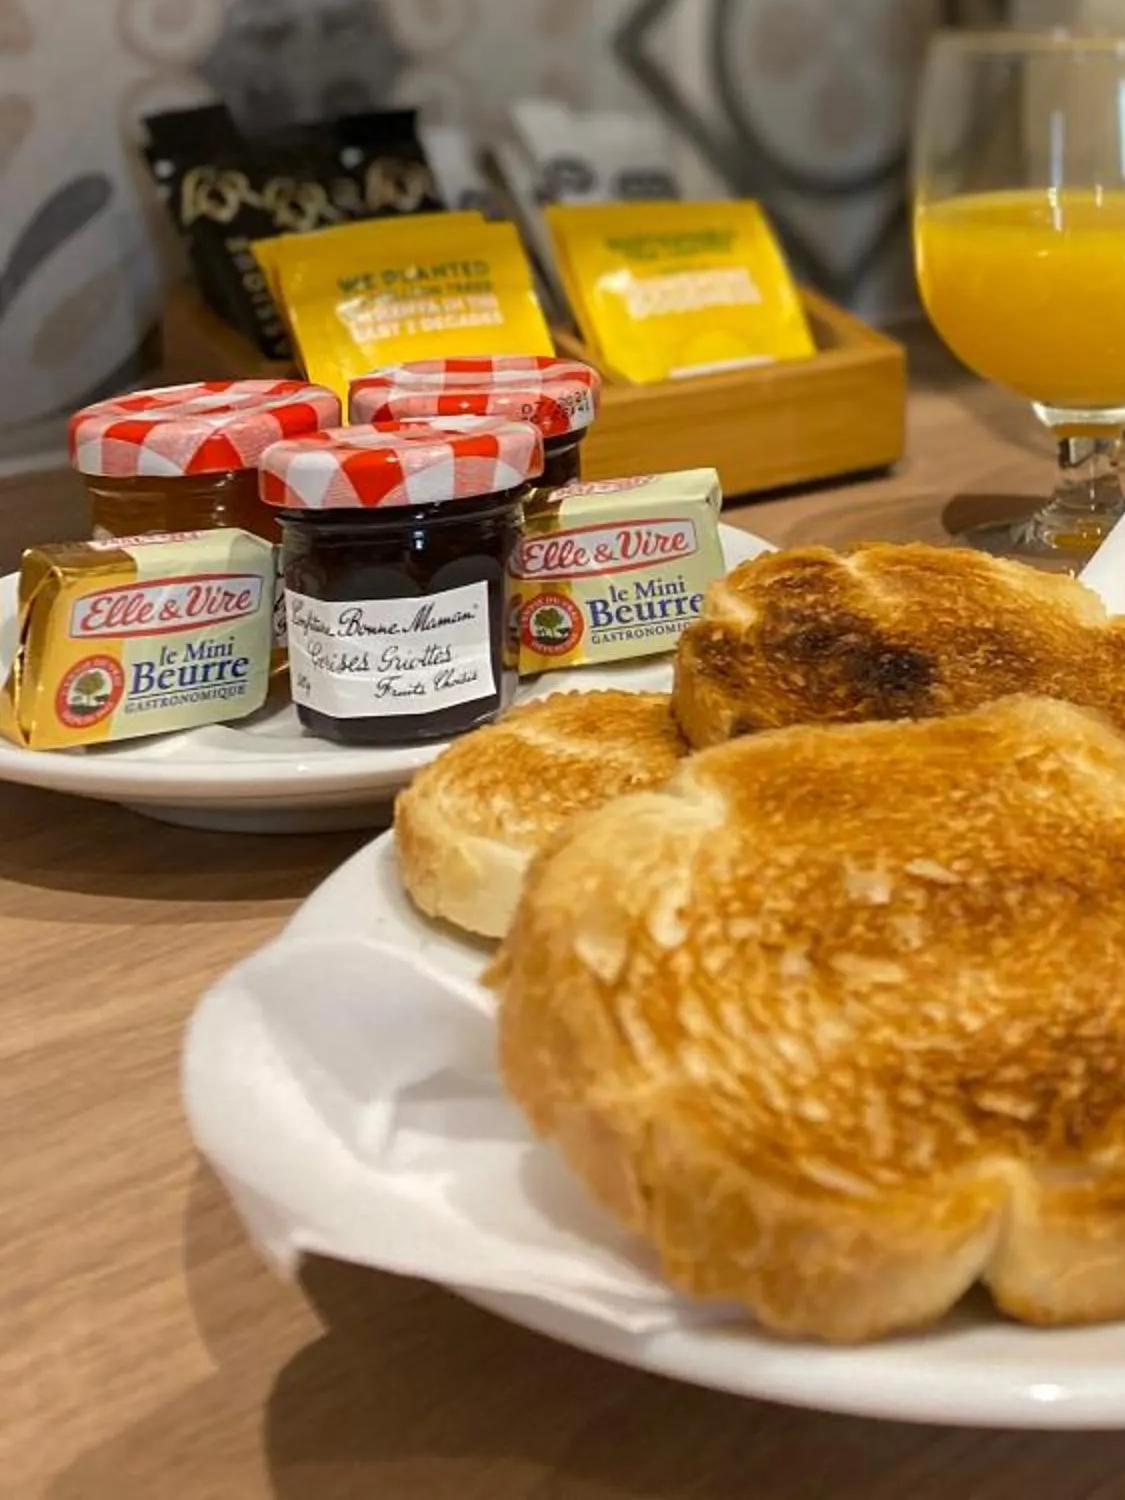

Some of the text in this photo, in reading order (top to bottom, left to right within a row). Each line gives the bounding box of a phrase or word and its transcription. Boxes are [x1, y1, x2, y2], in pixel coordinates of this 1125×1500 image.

[523, 530, 689, 574] Elle & Vire
[609, 574, 686, 602] le Mini
[80, 584, 251, 633] Elle & Vire
[337, 606, 401, 638] Bonne
[402, 602, 475, 634] Maman
[585, 592, 705, 629] Beurre
[160, 636, 235, 666] le Mini
[376, 643, 453, 673] Griottes
[129, 656, 250, 694] Beurre
[373, 675, 426, 699] Fruits
[124, 684, 247, 714] GASTRONOMIQUE
